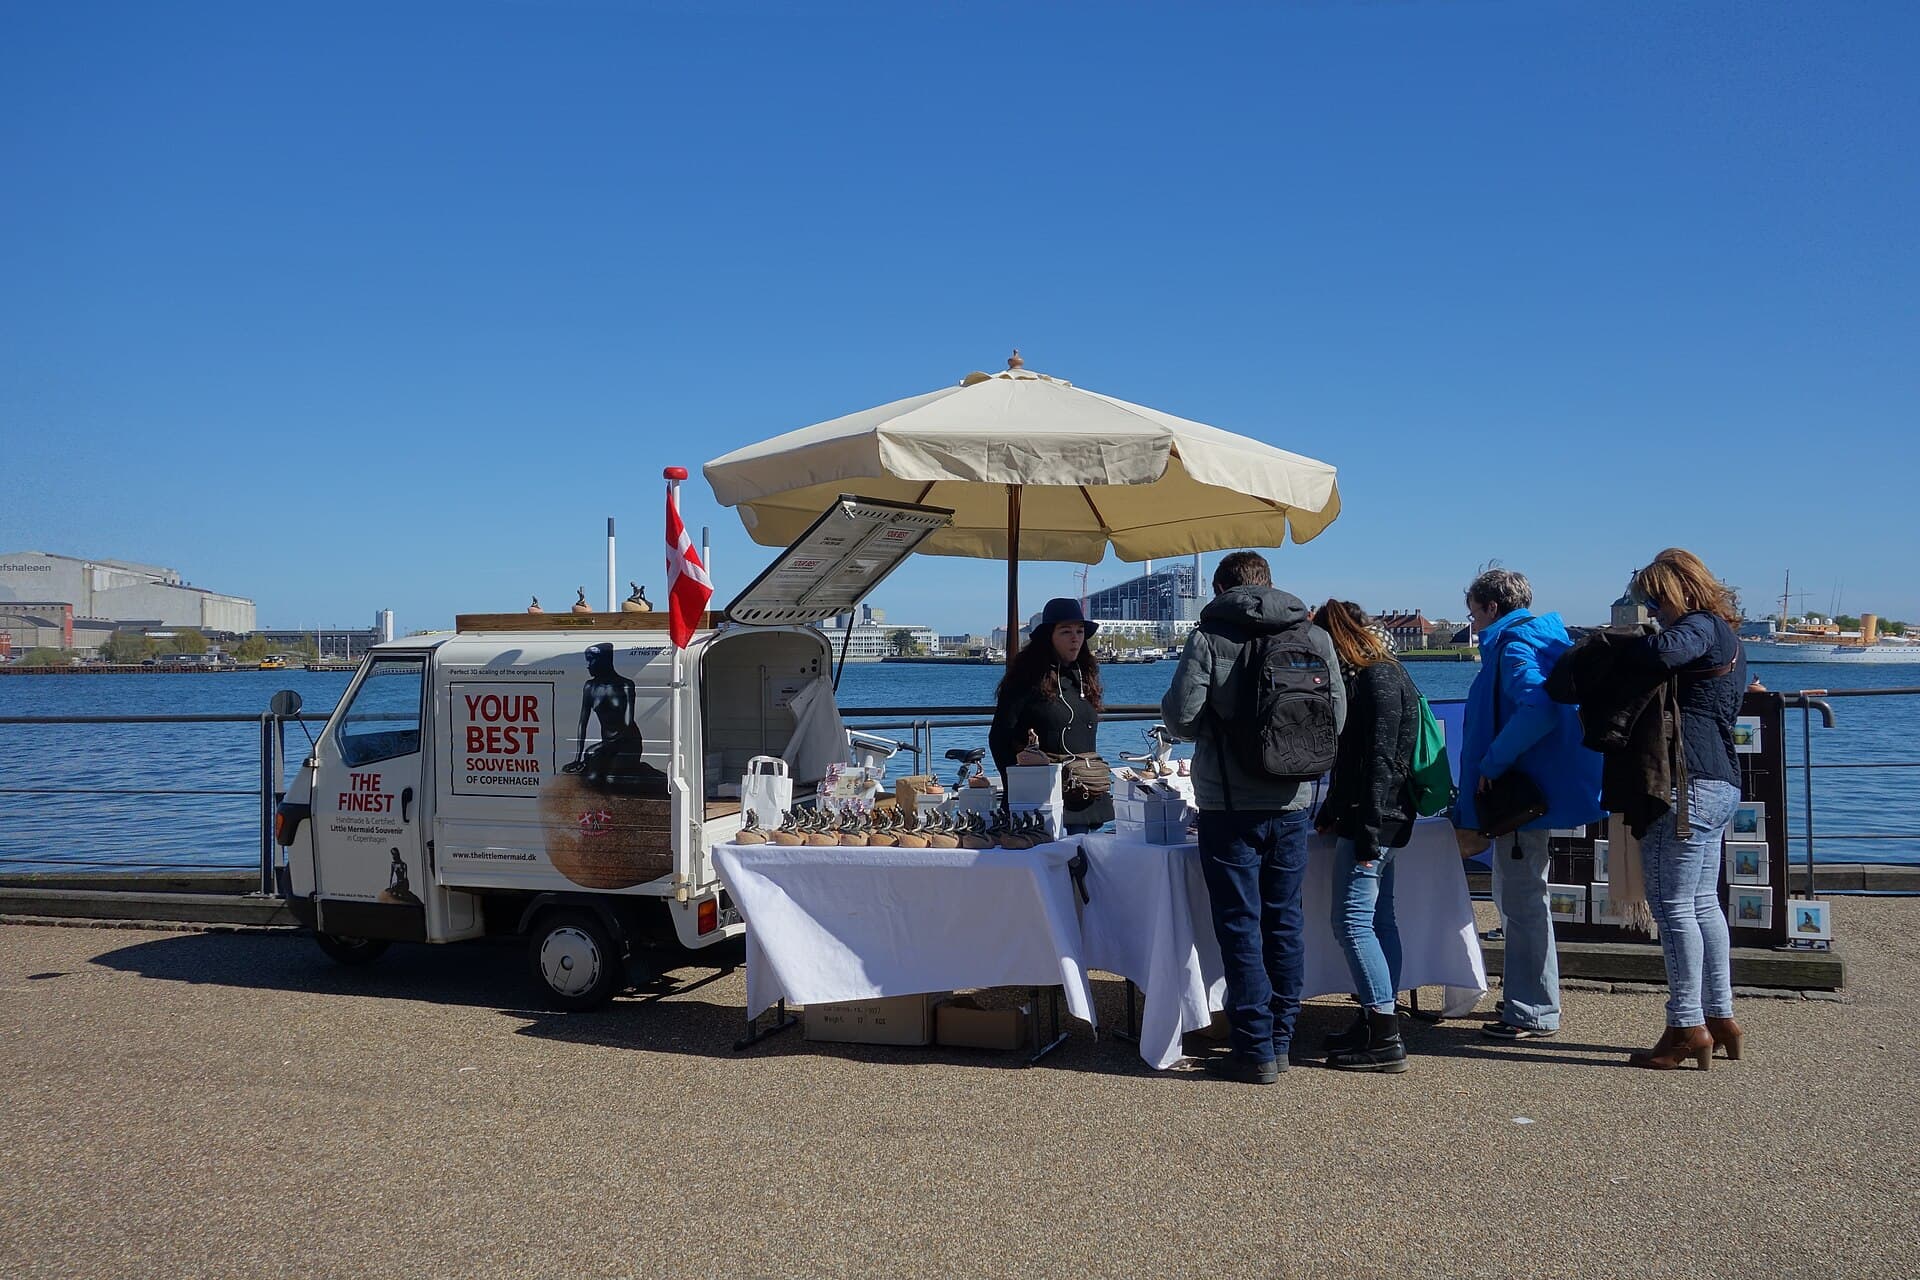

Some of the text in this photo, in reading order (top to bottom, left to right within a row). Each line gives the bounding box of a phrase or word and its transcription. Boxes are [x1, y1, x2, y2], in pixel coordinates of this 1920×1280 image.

[464, 694, 539, 723] YOUR
[466, 726, 539, 755] BEST
[466, 757, 540, 773] SOUVENIR
[350, 773, 381, 792] THE
[466, 775, 540, 786] OF COPENHAGEN
[338, 793, 395, 813] FINEST
[331, 824, 404, 835] Little Mermaid Souvenir
[353, 834, 388, 845] Copenhagen
[452, 851, 537, 861] www.thelittlemermaid.dk
